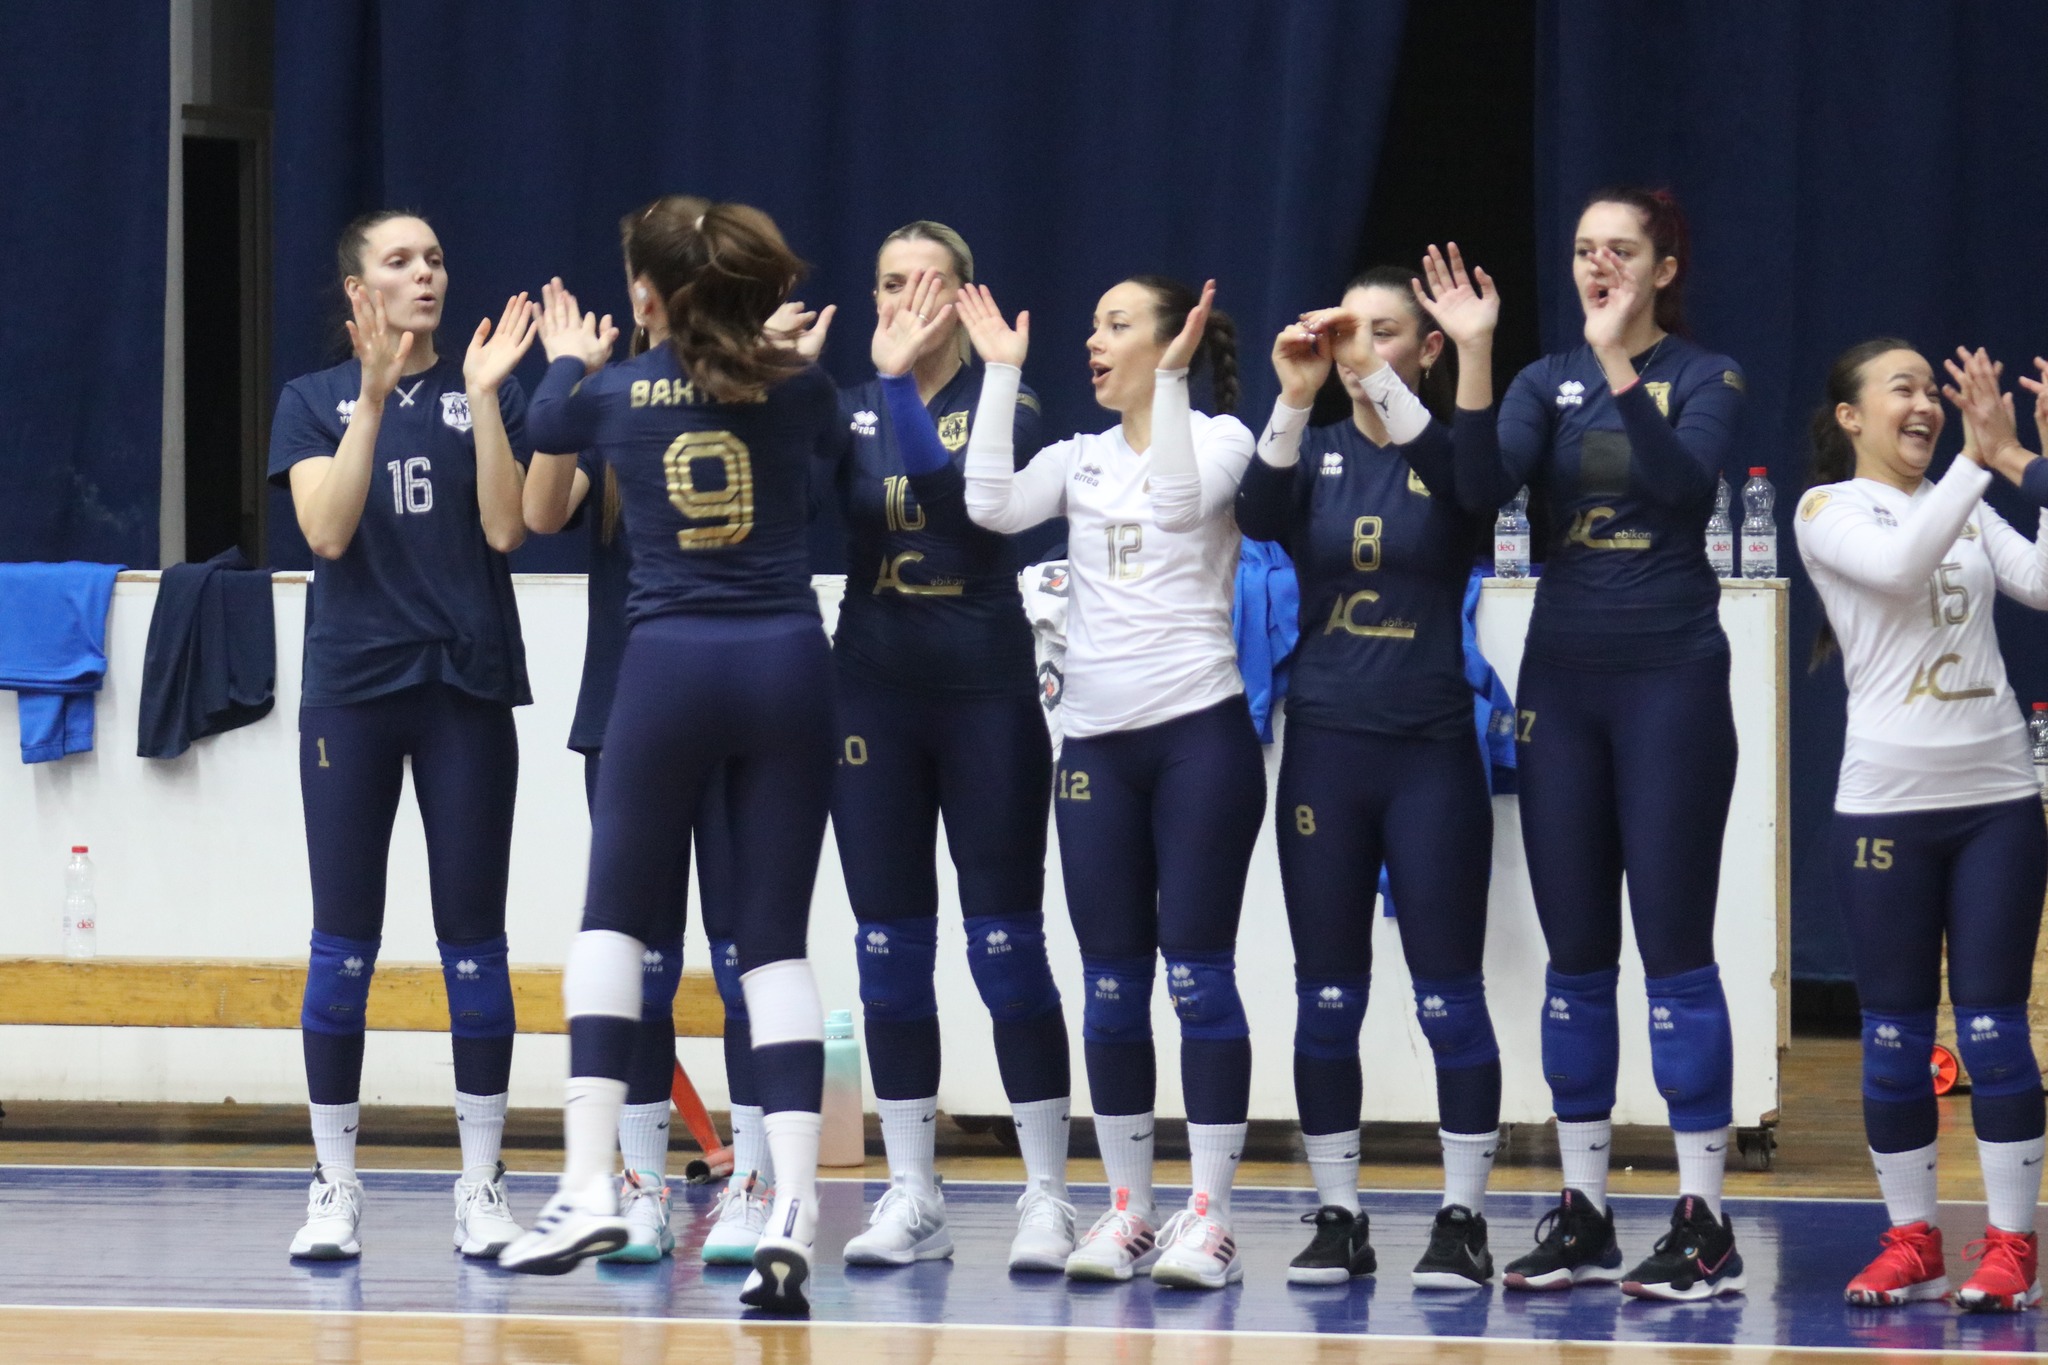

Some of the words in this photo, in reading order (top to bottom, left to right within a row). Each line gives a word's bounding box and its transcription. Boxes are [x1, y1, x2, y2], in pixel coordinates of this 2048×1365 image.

[850, 421, 876, 436] errea
[387, 456, 433, 514] 16
[662, 430, 755, 550] 9
[884, 475, 926, 532] 10
[1073, 470, 1100, 488] errea
[1104, 522, 1145, 582] 12
[1352, 515, 1383, 571] 8
[1929, 562, 1969, 627] 15
[1059, 769, 1092, 801] 12
[1295, 804, 1316, 835] 8
[1853, 837, 1895, 870] 15
